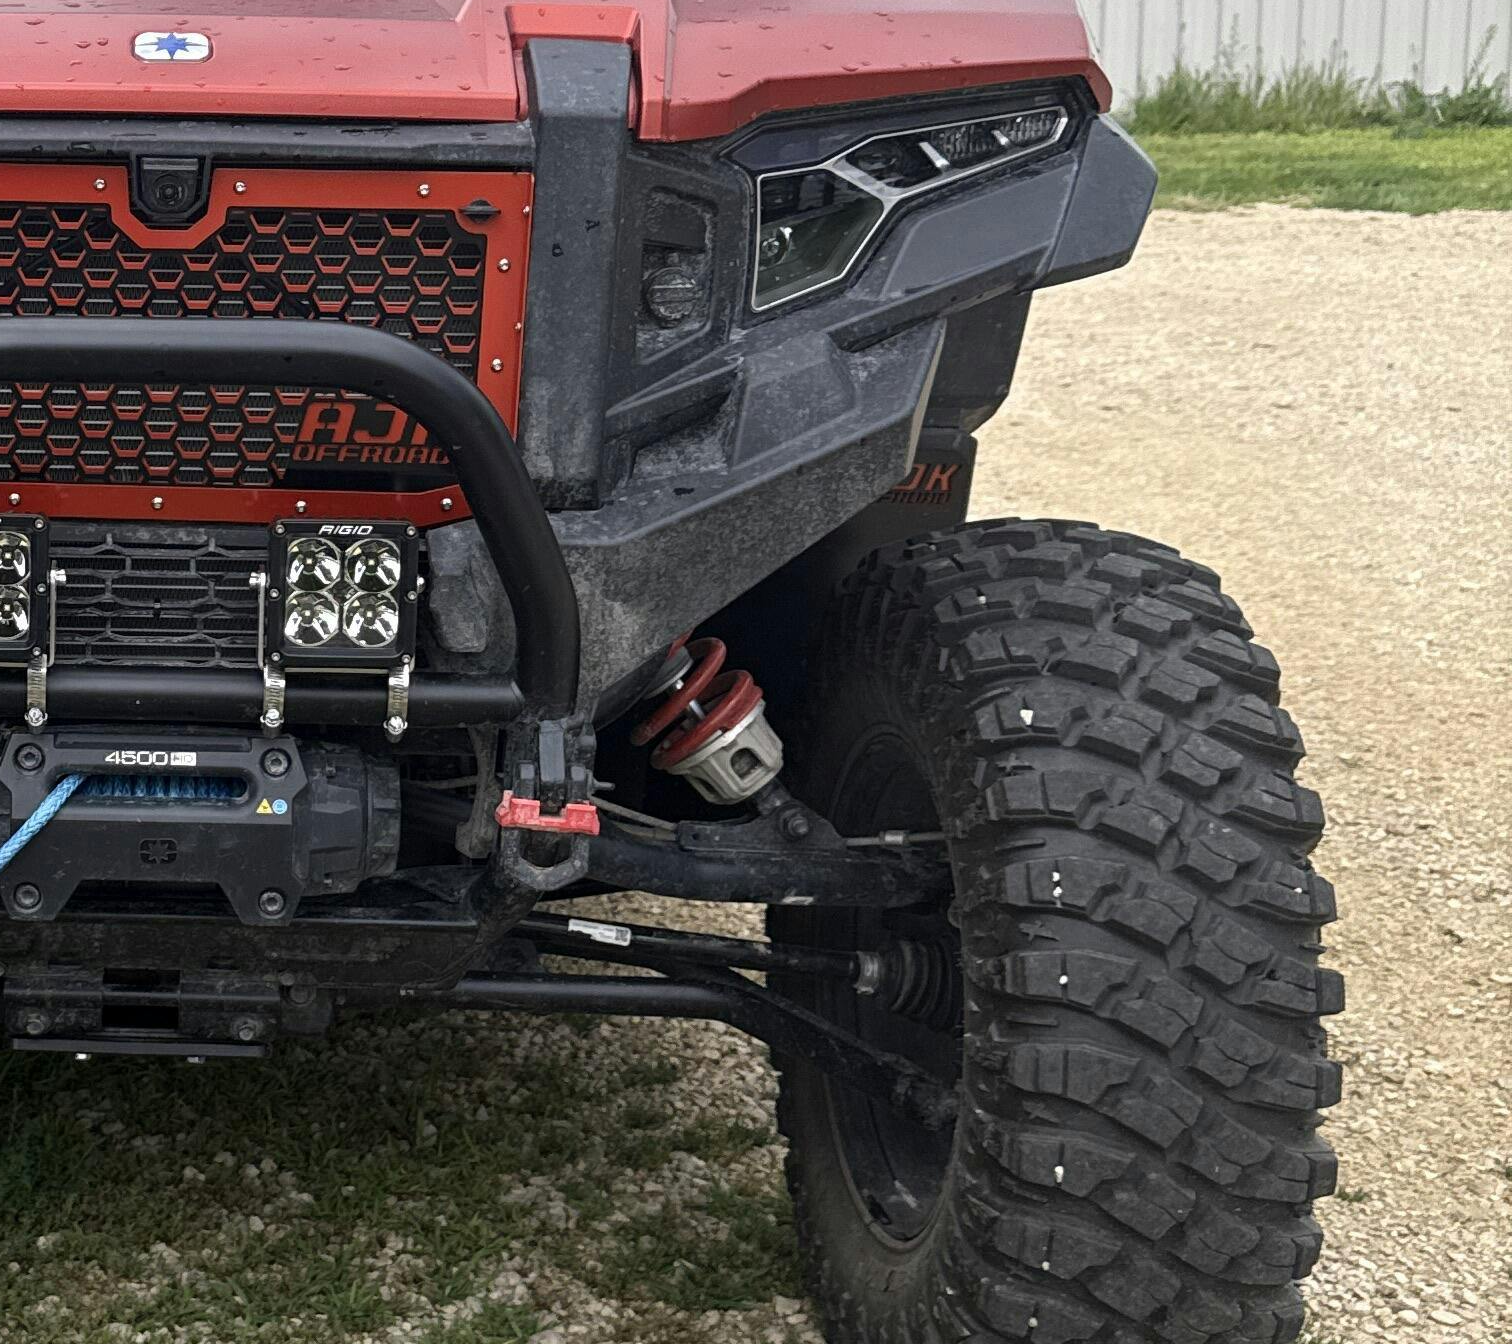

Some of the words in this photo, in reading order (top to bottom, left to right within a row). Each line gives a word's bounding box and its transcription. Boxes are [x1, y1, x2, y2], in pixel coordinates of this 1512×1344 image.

[296, 402, 428, 445] AJ
[292, 444, 451, 465] OFFROAD
[891, 463, 961, 491] JK
[318, 524, 374, 535] RIGID
[104, 750, 169, 766] 4500
[171, 752, 197, 766] HD
